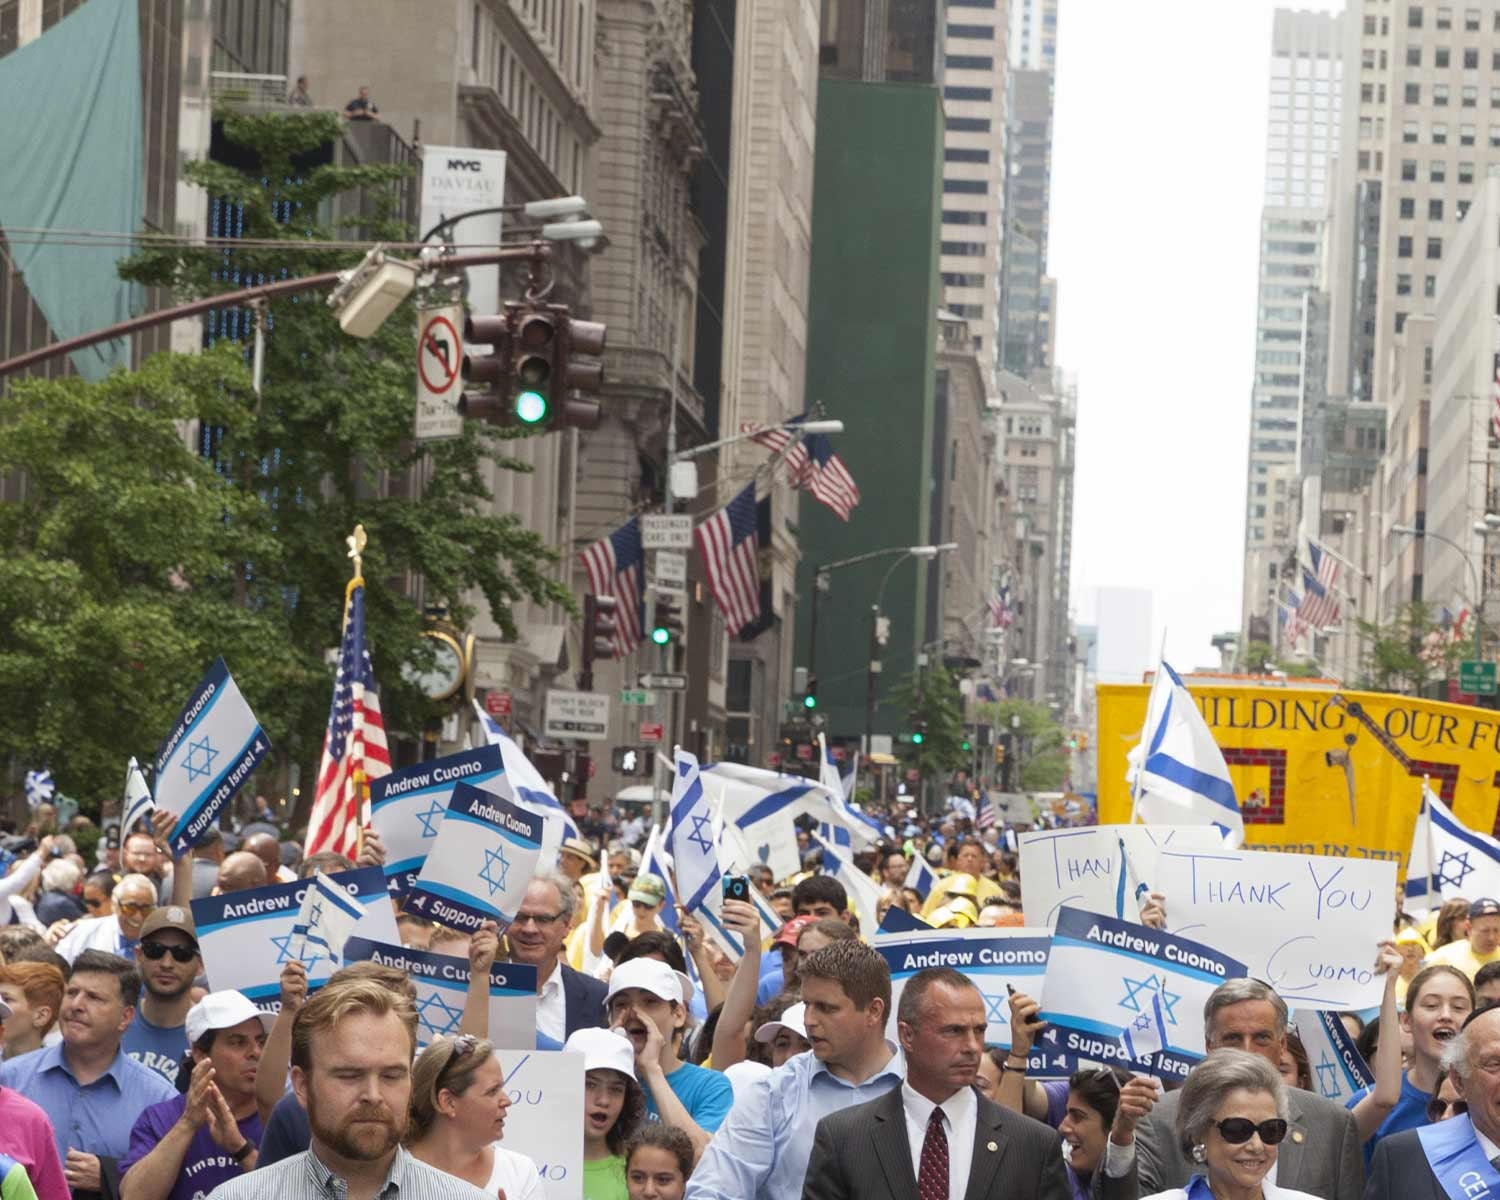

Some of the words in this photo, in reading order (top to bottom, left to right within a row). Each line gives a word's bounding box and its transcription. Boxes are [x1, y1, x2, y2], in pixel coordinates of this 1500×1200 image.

[448, 160, 482, 172] NYC
[158, 725, 185, 770] Andrew
[184, 683, 216, 725] Cuomo
[1384, 707, 1458, 746] OUR
[187, 784, 230, 838] Supports
[228, 751, 256, 789] Israel
[384, 773, 429, 797] Andrew
[433, 761, 482, 782] Cuomo
[469, 799, 506, 824] Andrew
[505, 812, 532, 837] Cuomo
[1024, 830, 1114, 889] THAN
[1162, 851, 1291, 905] THANK
[1308, 861, 1372, 920] YOU
[223, 894, 290, 919] Andrew
[370, 951, 437, 976] Andrew
[903, 951, 973, 970] Andrew
[979, 949, 1046, 964] Cuomo
[1086, 924, 1160, 956] Andrew
[1164, 944, 1226, 976] Cuomo
[1322, 1010, 1345, 1050] ndrew
[1343, 1050, 1368, 1089] Cuom
